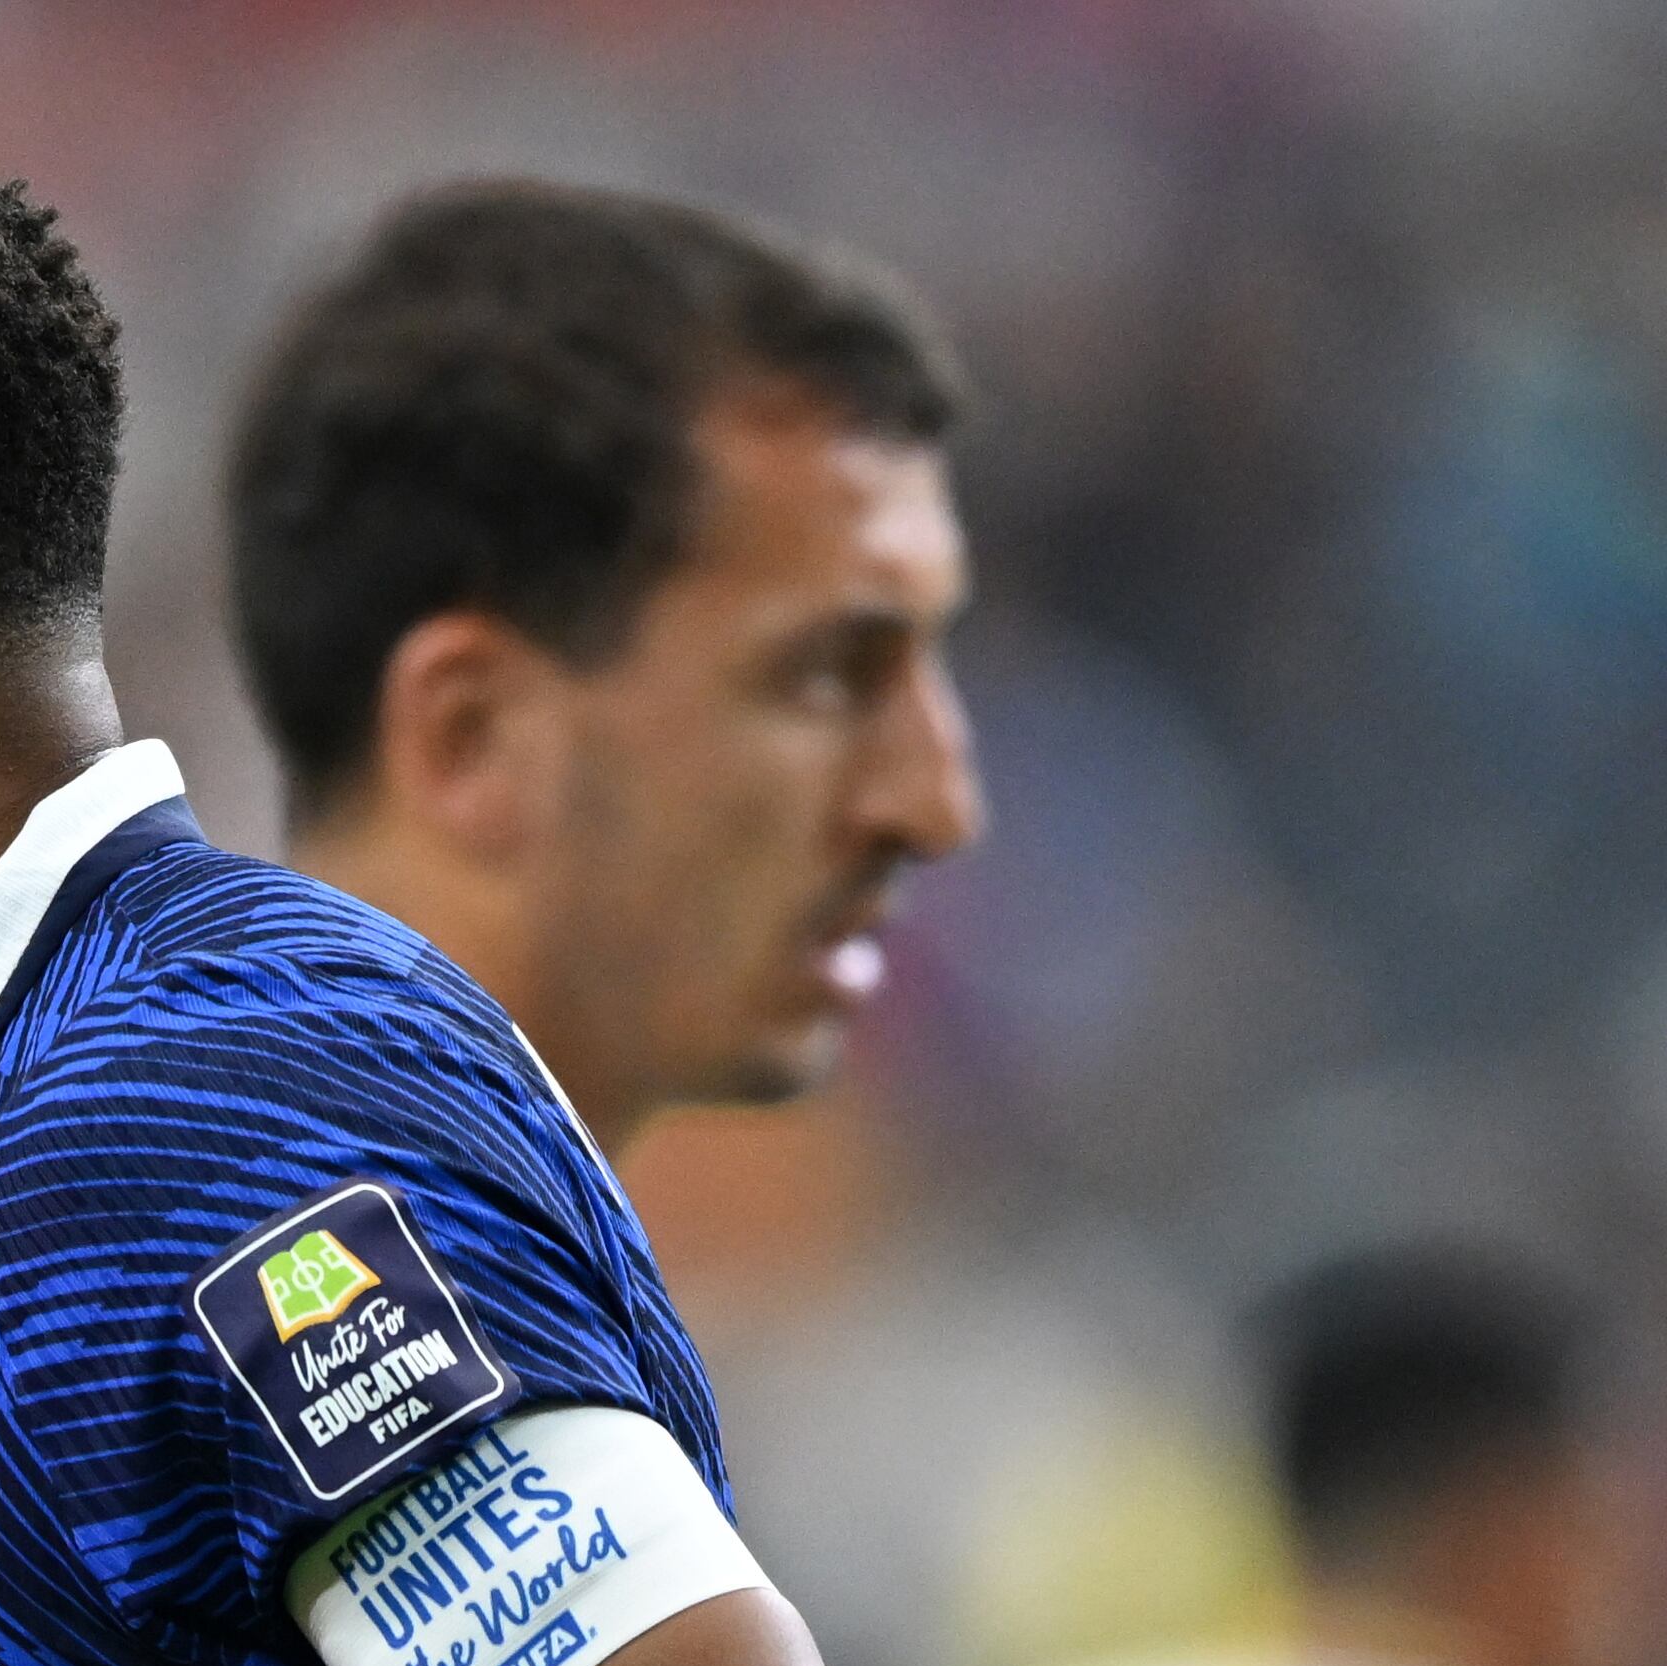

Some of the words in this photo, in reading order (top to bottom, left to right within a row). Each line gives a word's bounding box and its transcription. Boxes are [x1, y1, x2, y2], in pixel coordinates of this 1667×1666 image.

[291, 1323, 367, 1393] Unite
[359, 1297, 405, 1347] For
[299, 1329, 458, 1448] EDUCATION
[369, 1397, 431, 1445] FIFA
[329, 1427, 529, 1596] FOOTBALL
[360, 1467, 573, 1650] UNITES
[465, 1507, 627, 1645] World
